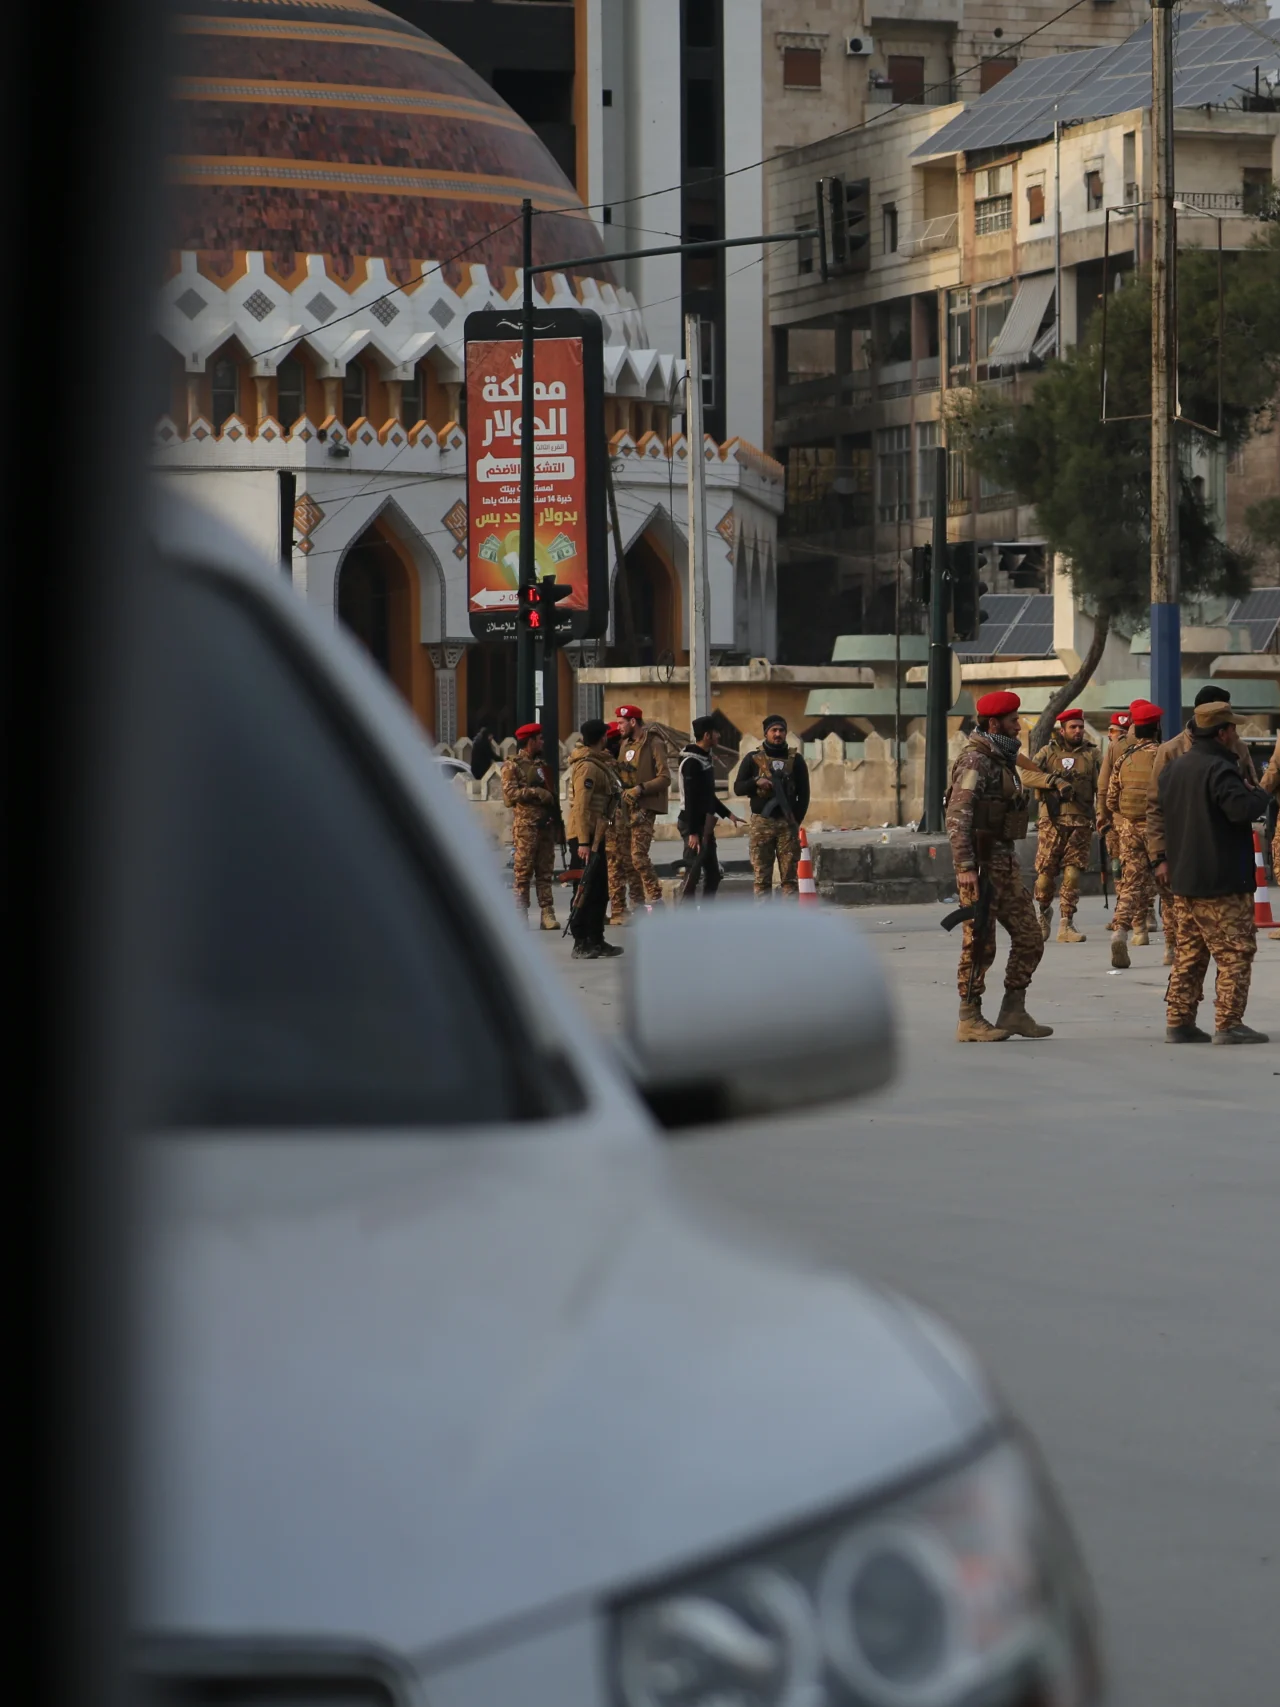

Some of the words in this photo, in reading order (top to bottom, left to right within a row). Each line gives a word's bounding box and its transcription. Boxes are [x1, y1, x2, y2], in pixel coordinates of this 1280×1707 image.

[482, 374, 566, 402] مملكة
[499, 485, 515, 494] بيتك
[547, 495, 556, 503] 14
[556, 494, 572, 505] خبرة
[475, 512, 501, 528] بس
[538, 507, 578, 527] بدولار
